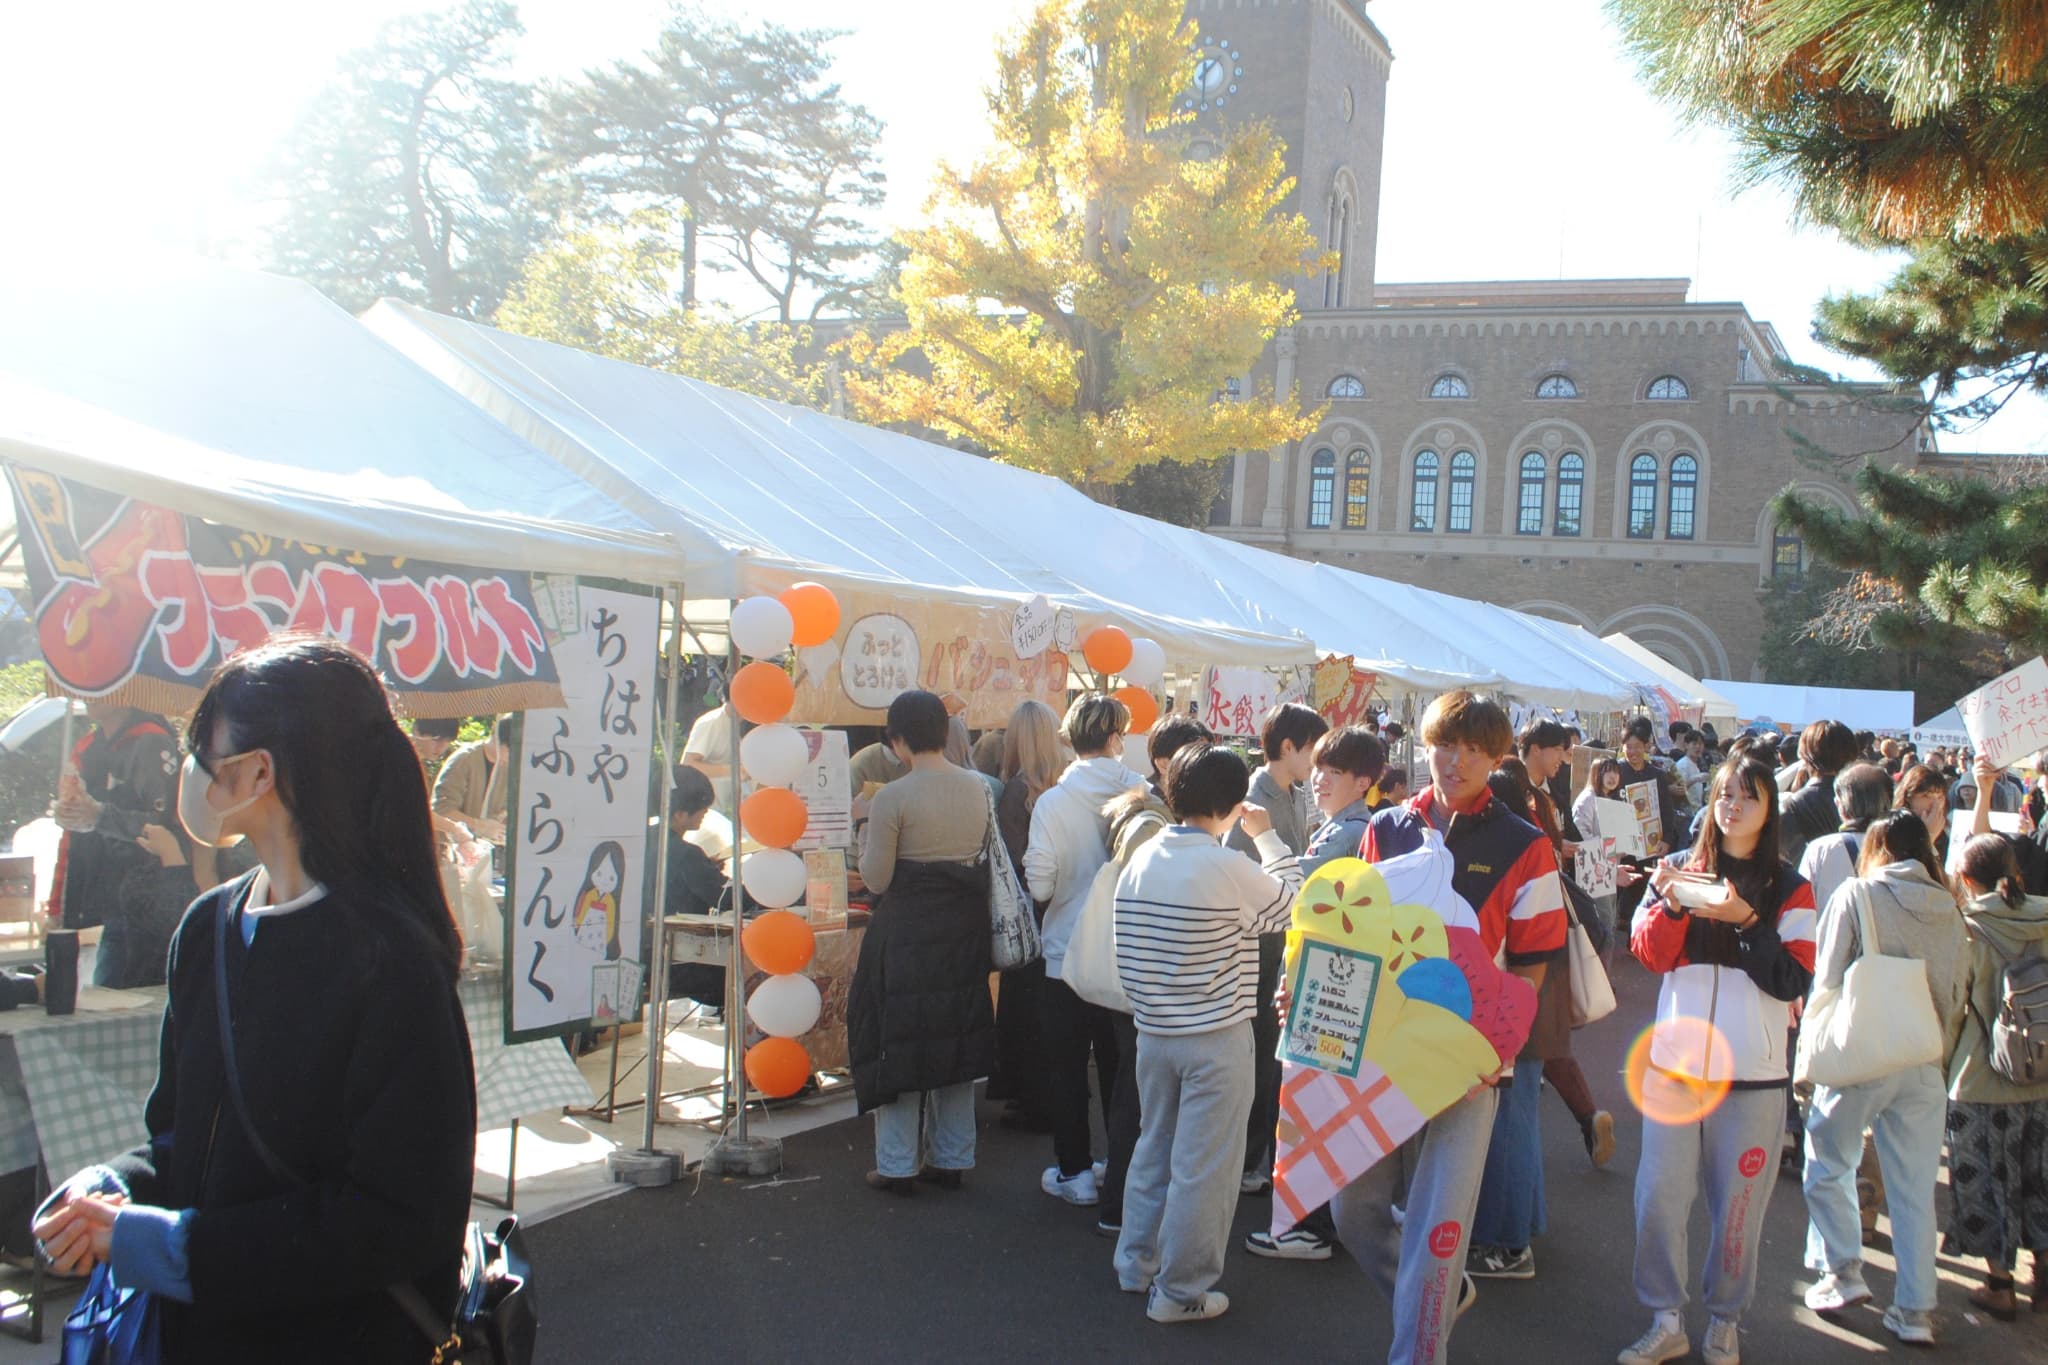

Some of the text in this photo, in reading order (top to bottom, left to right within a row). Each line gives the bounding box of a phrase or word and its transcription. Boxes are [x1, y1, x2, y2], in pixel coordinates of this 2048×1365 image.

[138, 549, 546, 684] フランクフルト
[587, 606, 641, 804] ちはや
[1205, 687, 1268, 735] 水餃
[817, 766, 828, 788] 5
[523, 716, 576, 1003] ふらんく
[1315, 1011, 1363, 1029] ブルーベリー
[1319, 1039, 1342, 1056] 500
